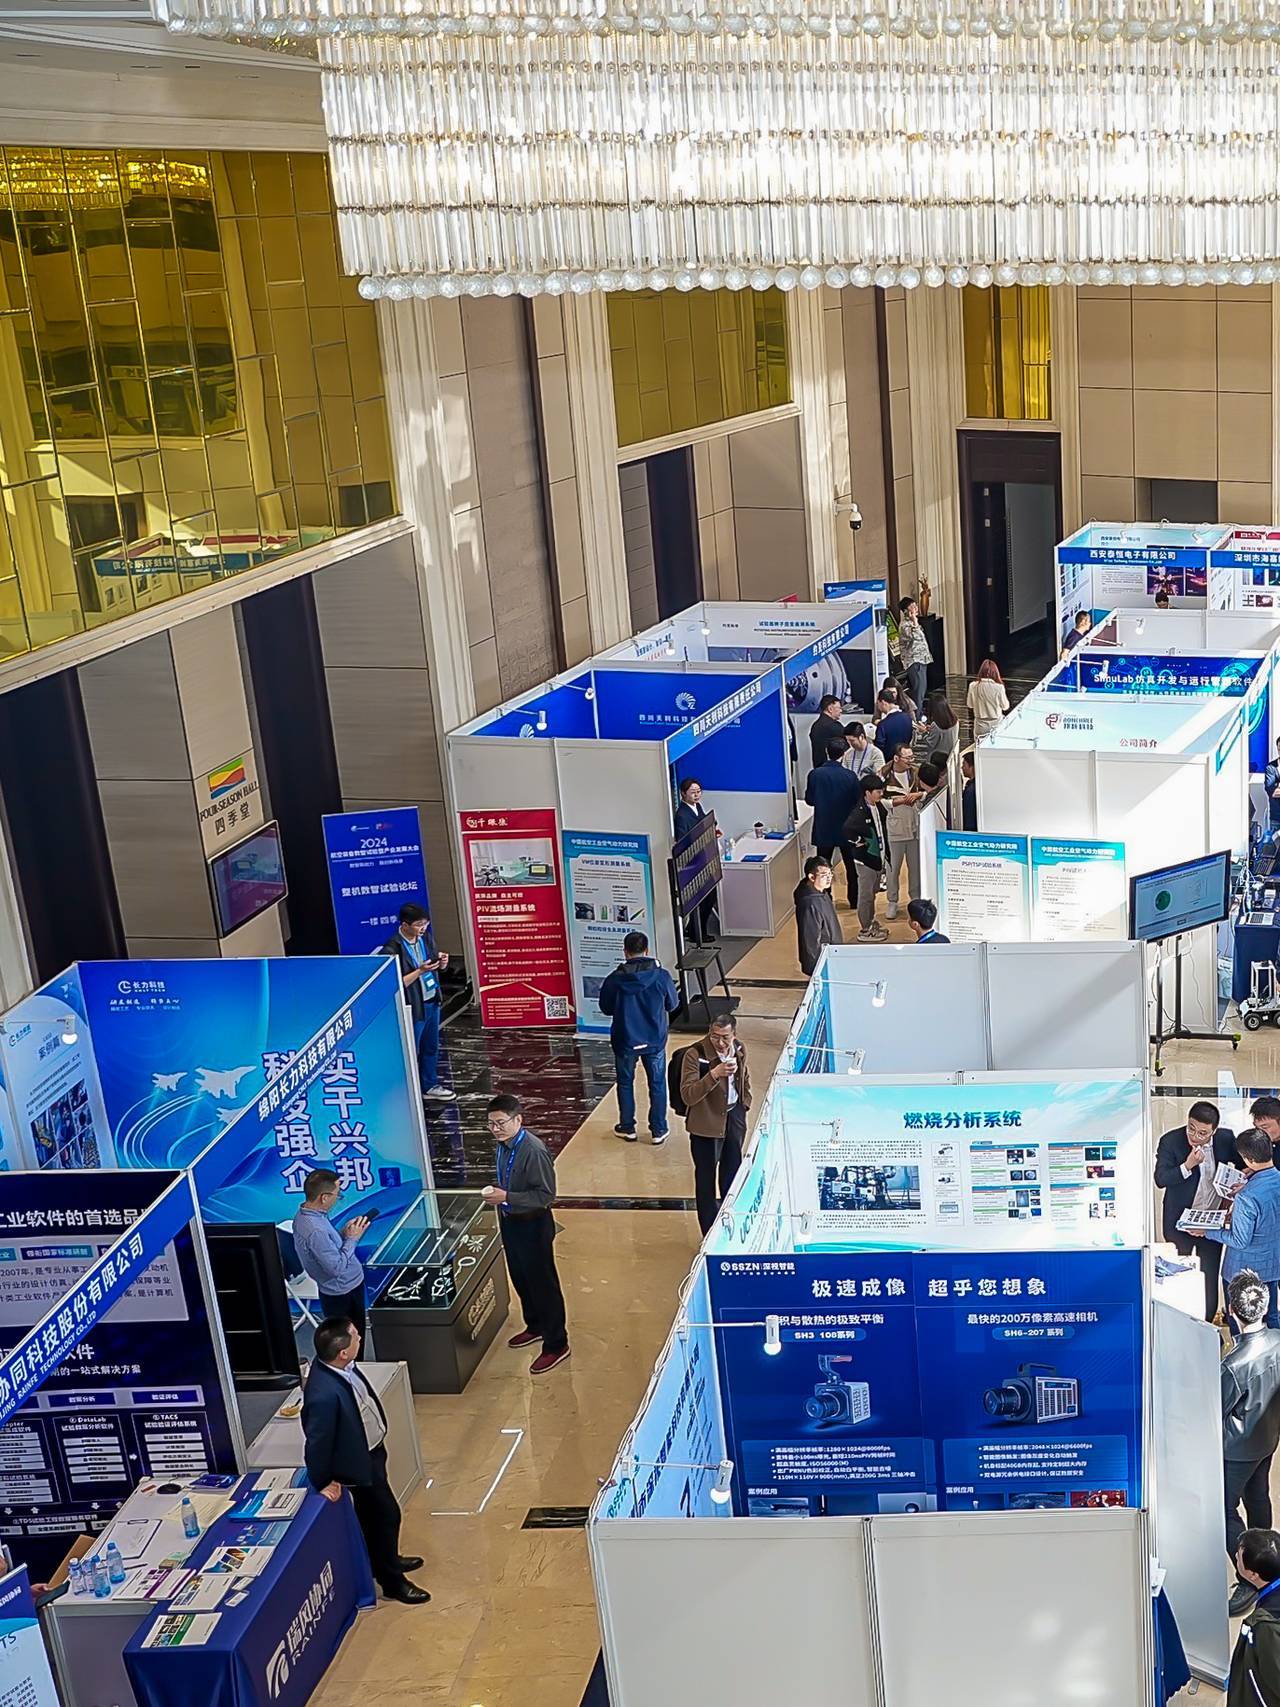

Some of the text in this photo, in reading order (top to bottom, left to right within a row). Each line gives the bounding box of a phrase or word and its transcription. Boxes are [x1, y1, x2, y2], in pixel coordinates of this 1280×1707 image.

[215, 801, 251, 836] 四季堂
[360, 838, 388, 848] 2024
[258, 1009, 352, 1122] 绵阳长力科技有限公司
[903, 1109, 1022, 1130] 燃烧分析系统
[731, 1262, 795, 1271] SSZN 深视智能
[811, 1277, 1047, 1298] 极速成像 超乎您想象
[778, 1313, 885, 1327] 积与散热的极致平衡
[967, 1311, 1099, 1325] 最快的200万像素高速相机
[1046, 1327, 1064, 1337] 系列
[40, 1332, 76, 1375] TECHNOLOGY
[286, 1560, 334, 1654] 瑞风协同
